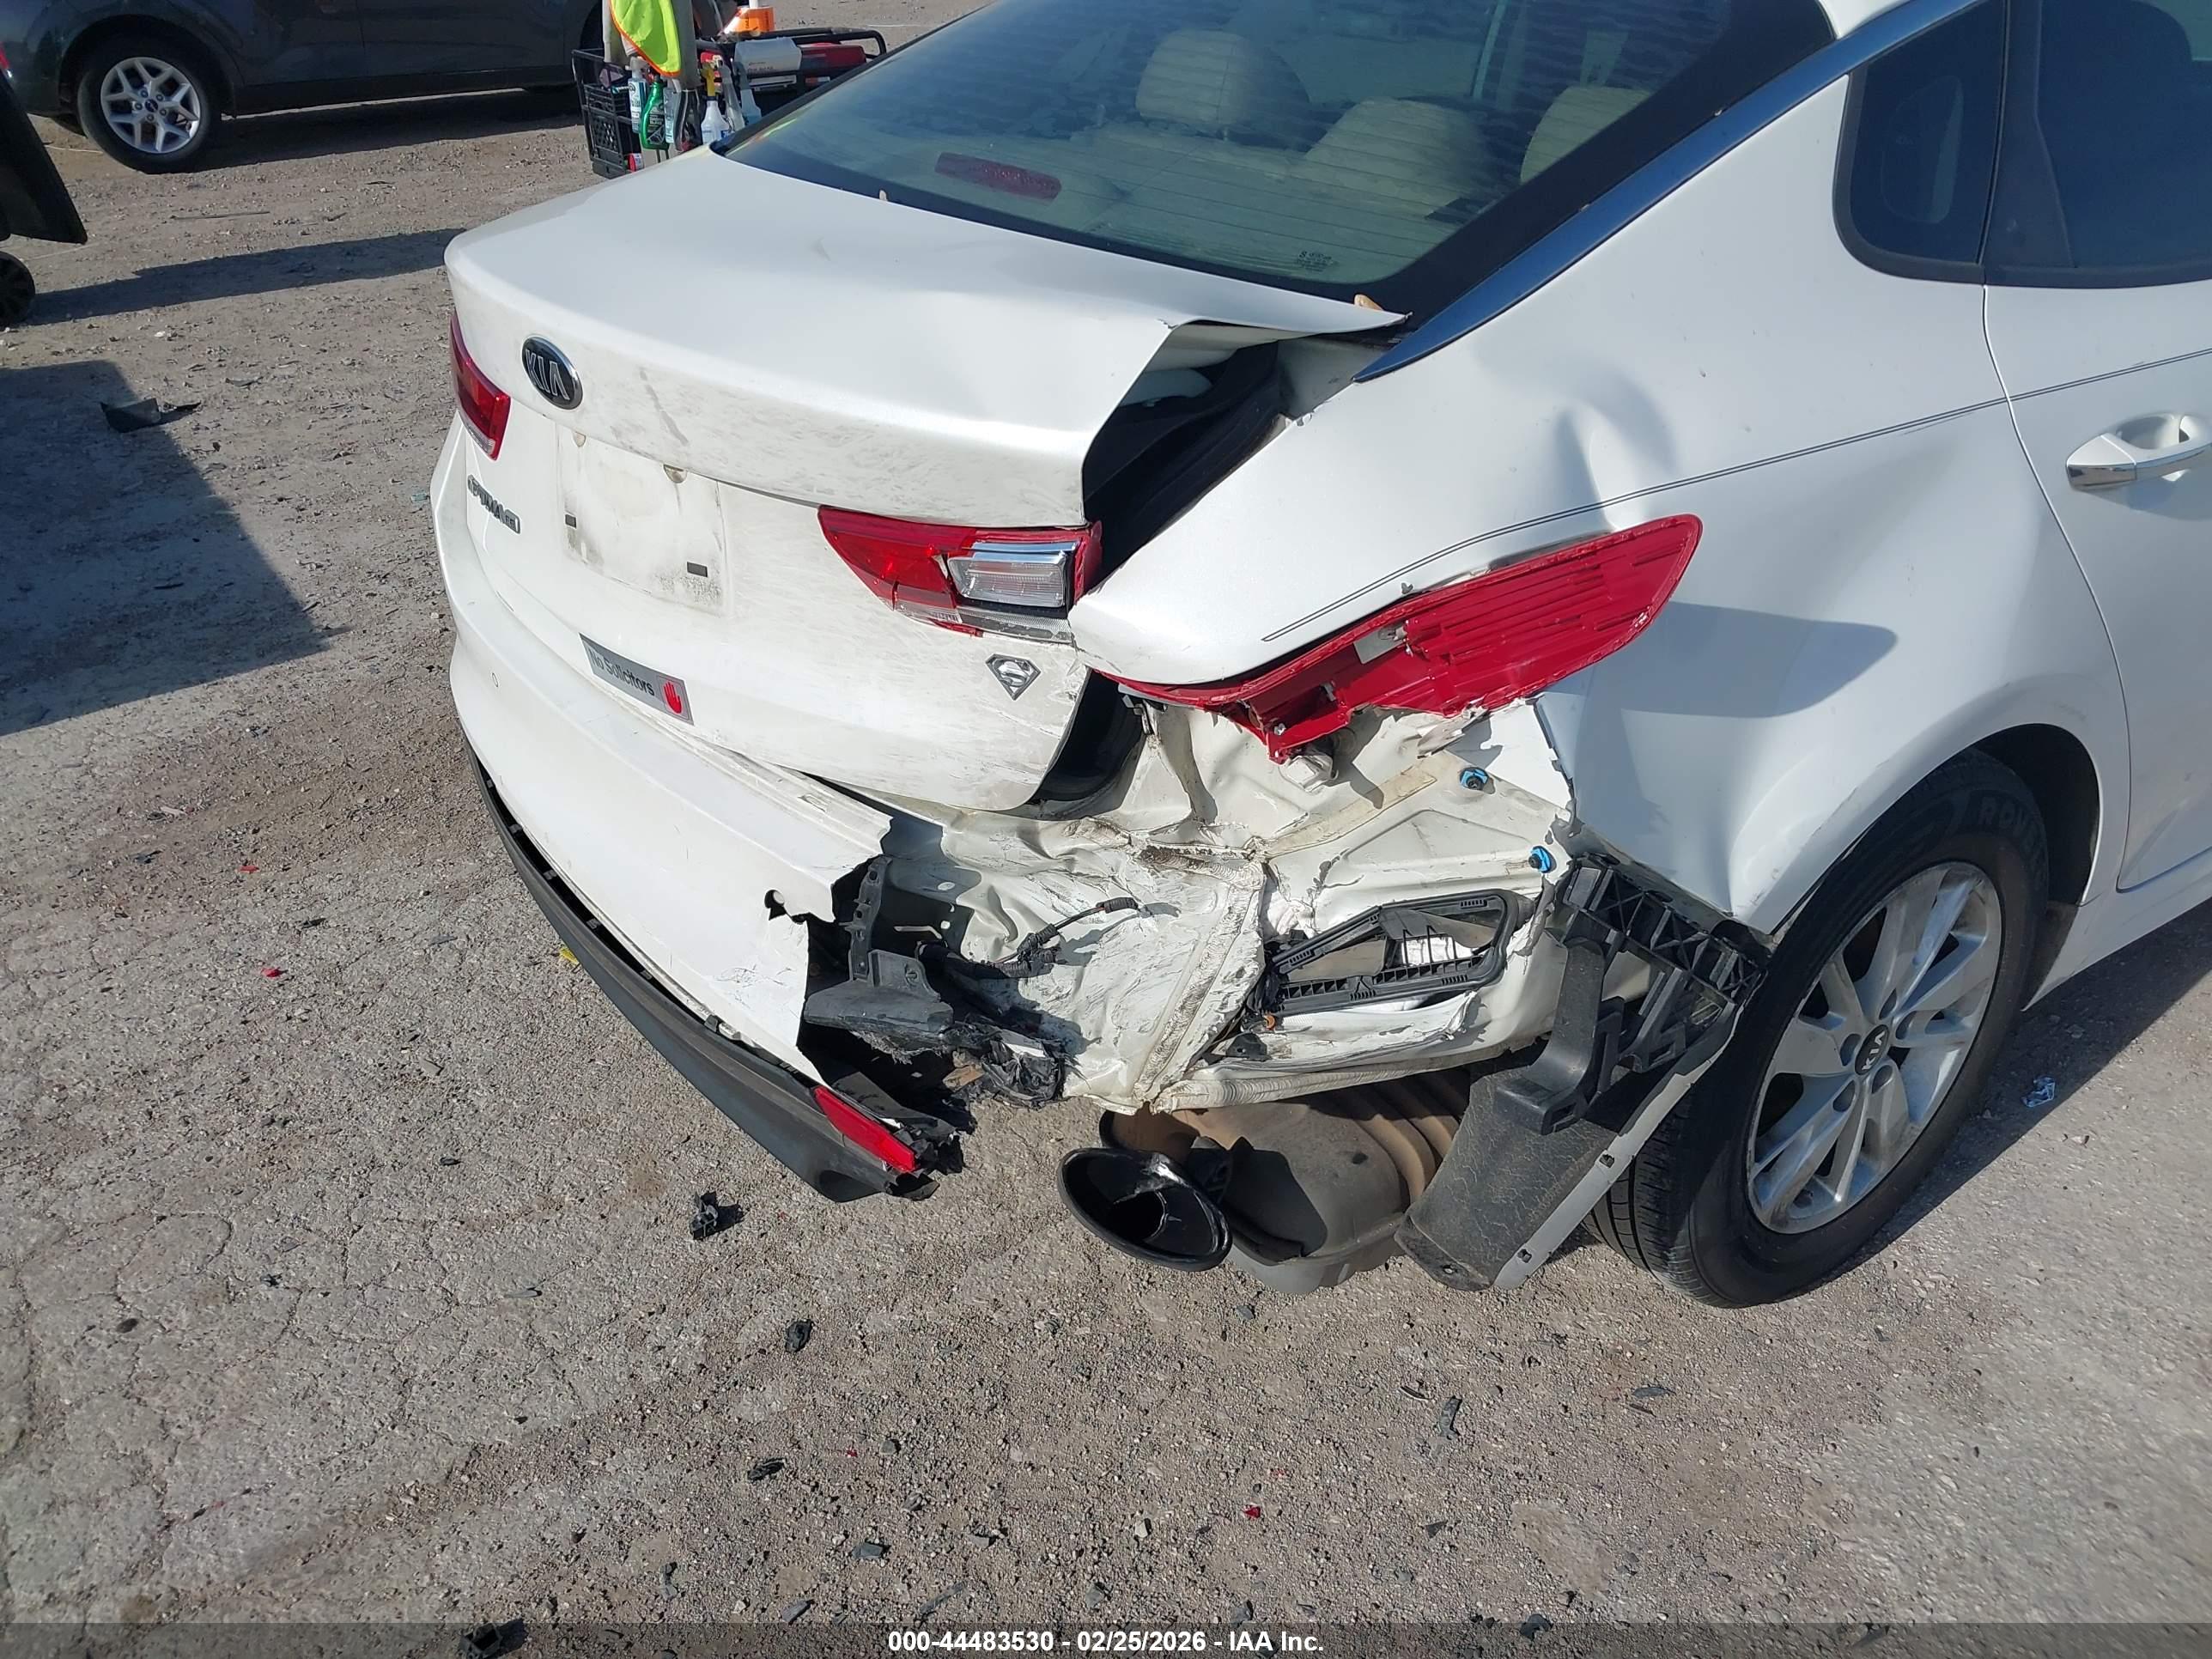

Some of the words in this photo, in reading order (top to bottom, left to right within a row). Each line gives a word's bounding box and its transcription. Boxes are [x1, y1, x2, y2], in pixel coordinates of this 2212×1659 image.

[526, 348, 570, 400] KIA
[588, 648, 605, 671] No
[603, 656, 655, 697] Solicitors
[1862, 1030, 1887, 1071] KIA
